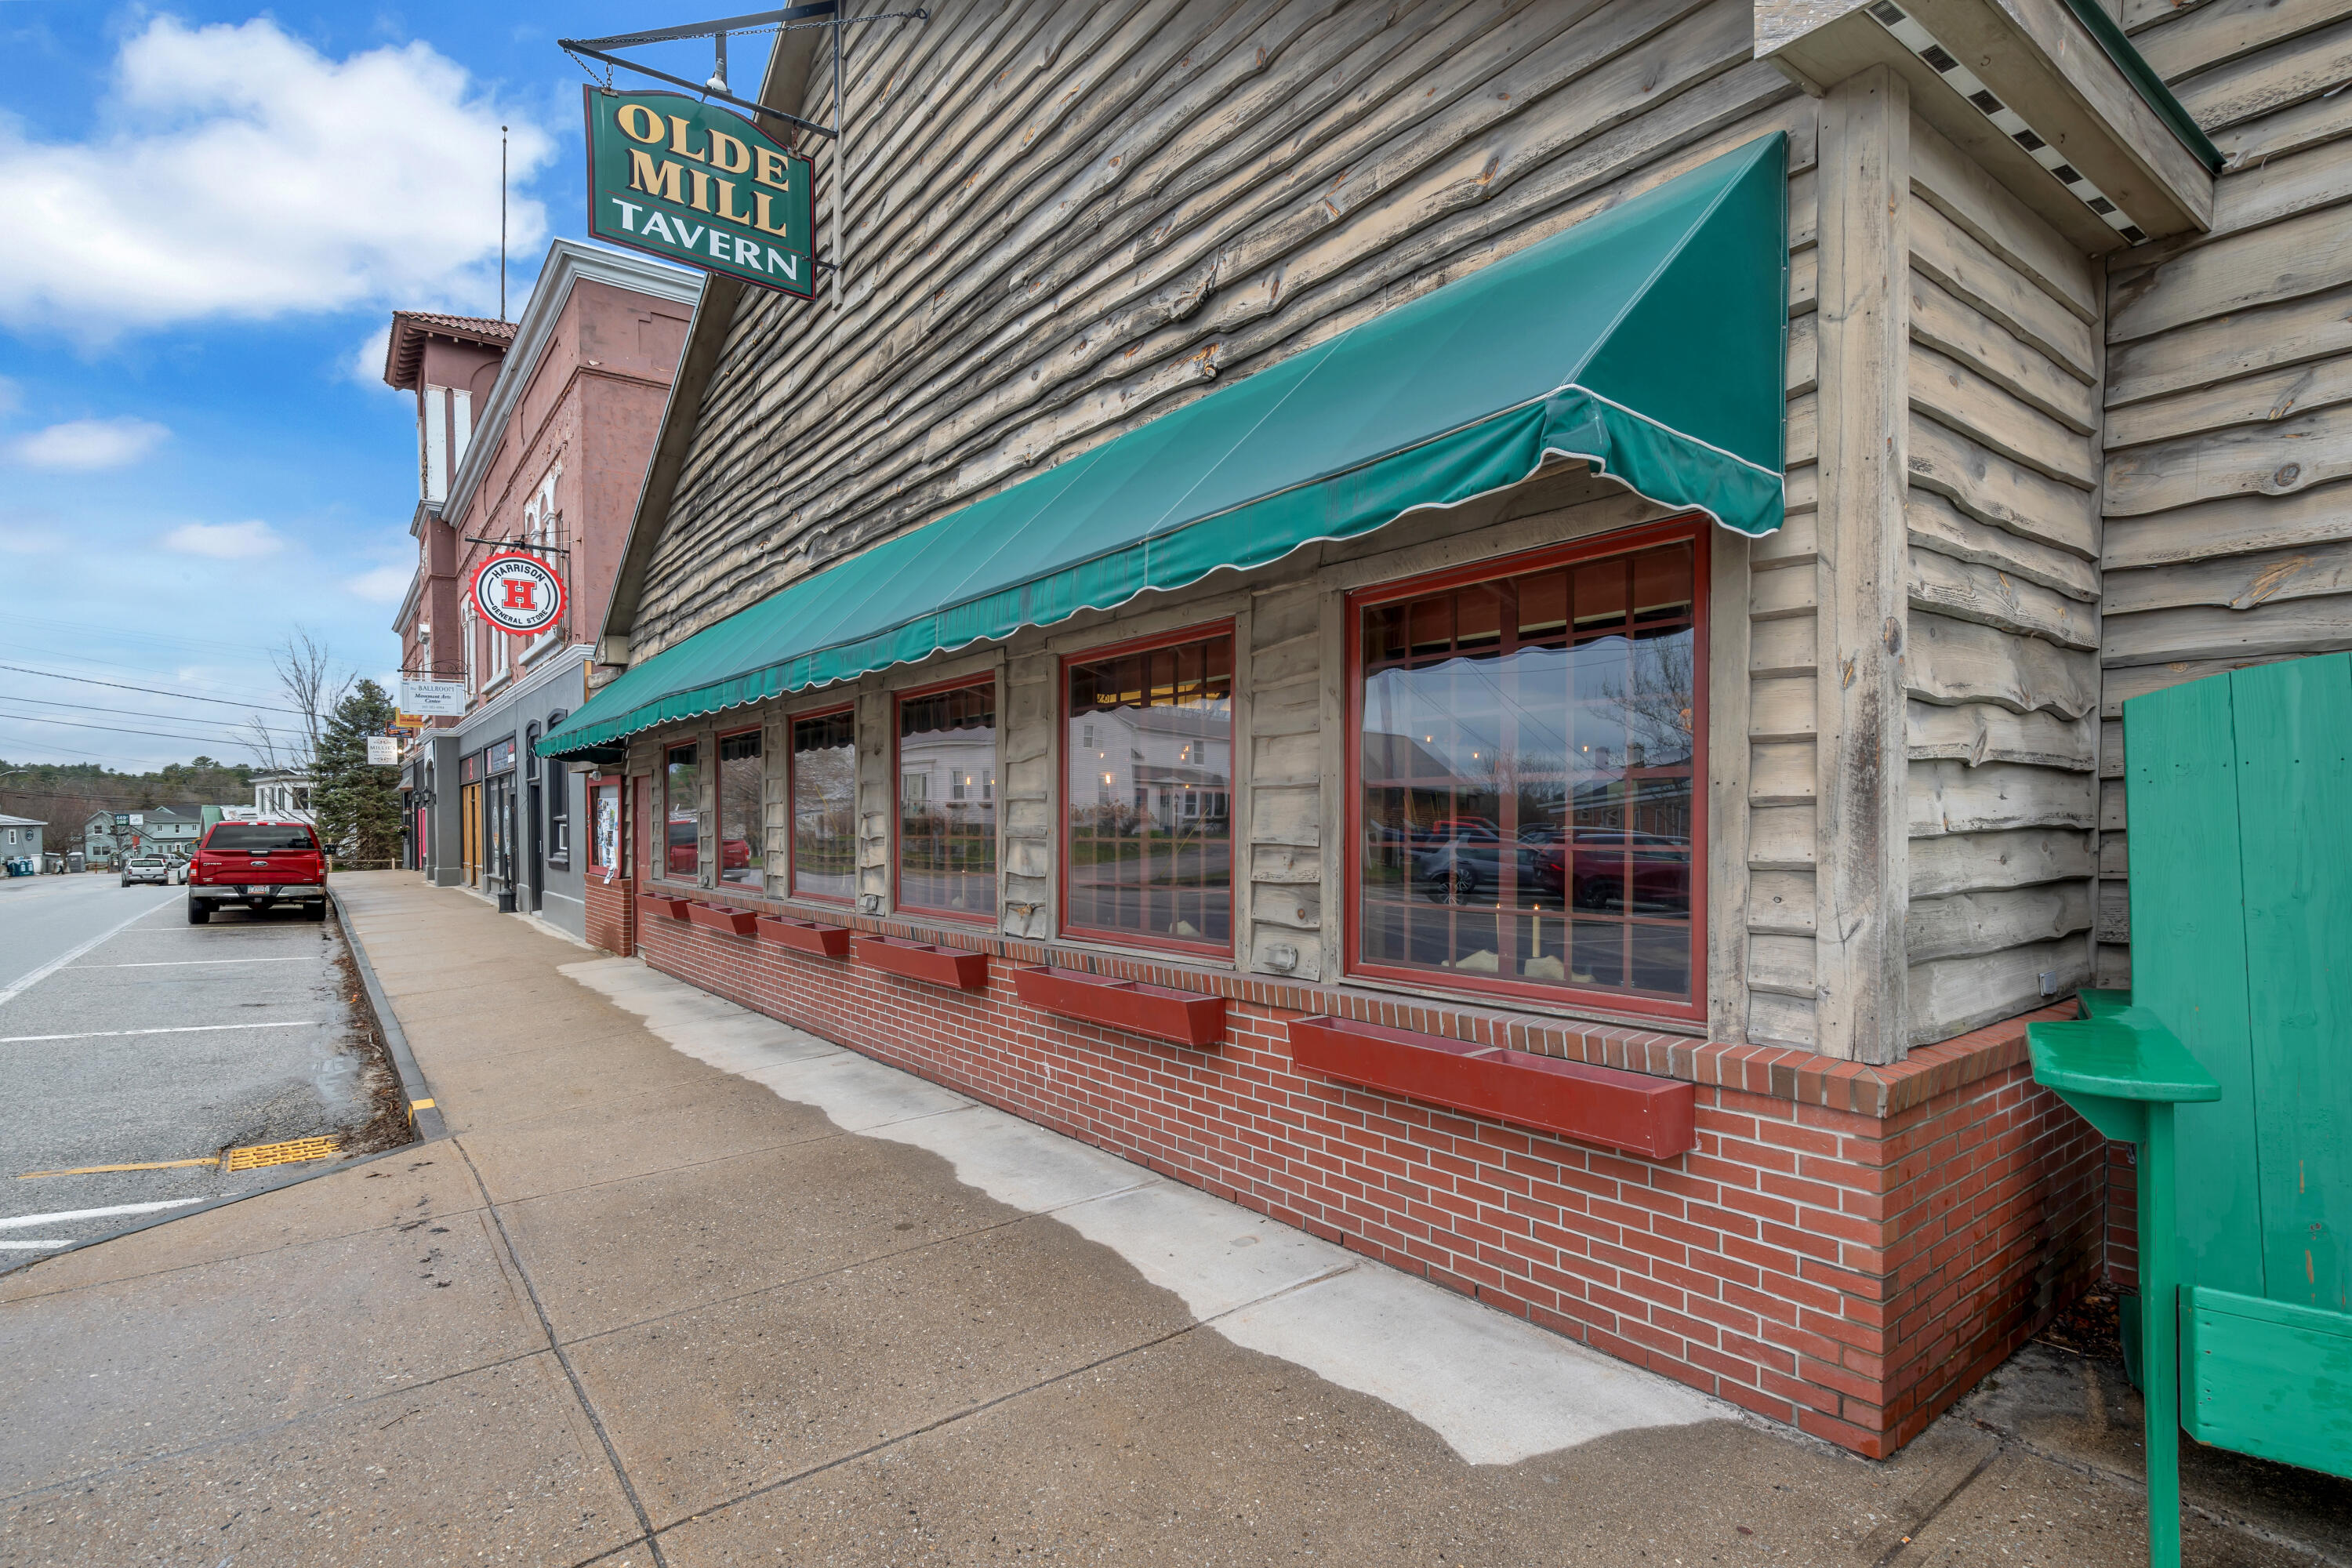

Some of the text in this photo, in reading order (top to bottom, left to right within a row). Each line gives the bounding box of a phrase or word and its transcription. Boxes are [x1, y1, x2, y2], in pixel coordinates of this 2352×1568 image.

[615, 103, 789, 193] OLDE
[626, 147, 787, 238] MILL
[612, 198, 797, 281] TAVERN
[492, 564, 546, 583] HARRISON
[502, 578, 538, 612] H
[492, 604, 548, 624] GENERAL STORE
